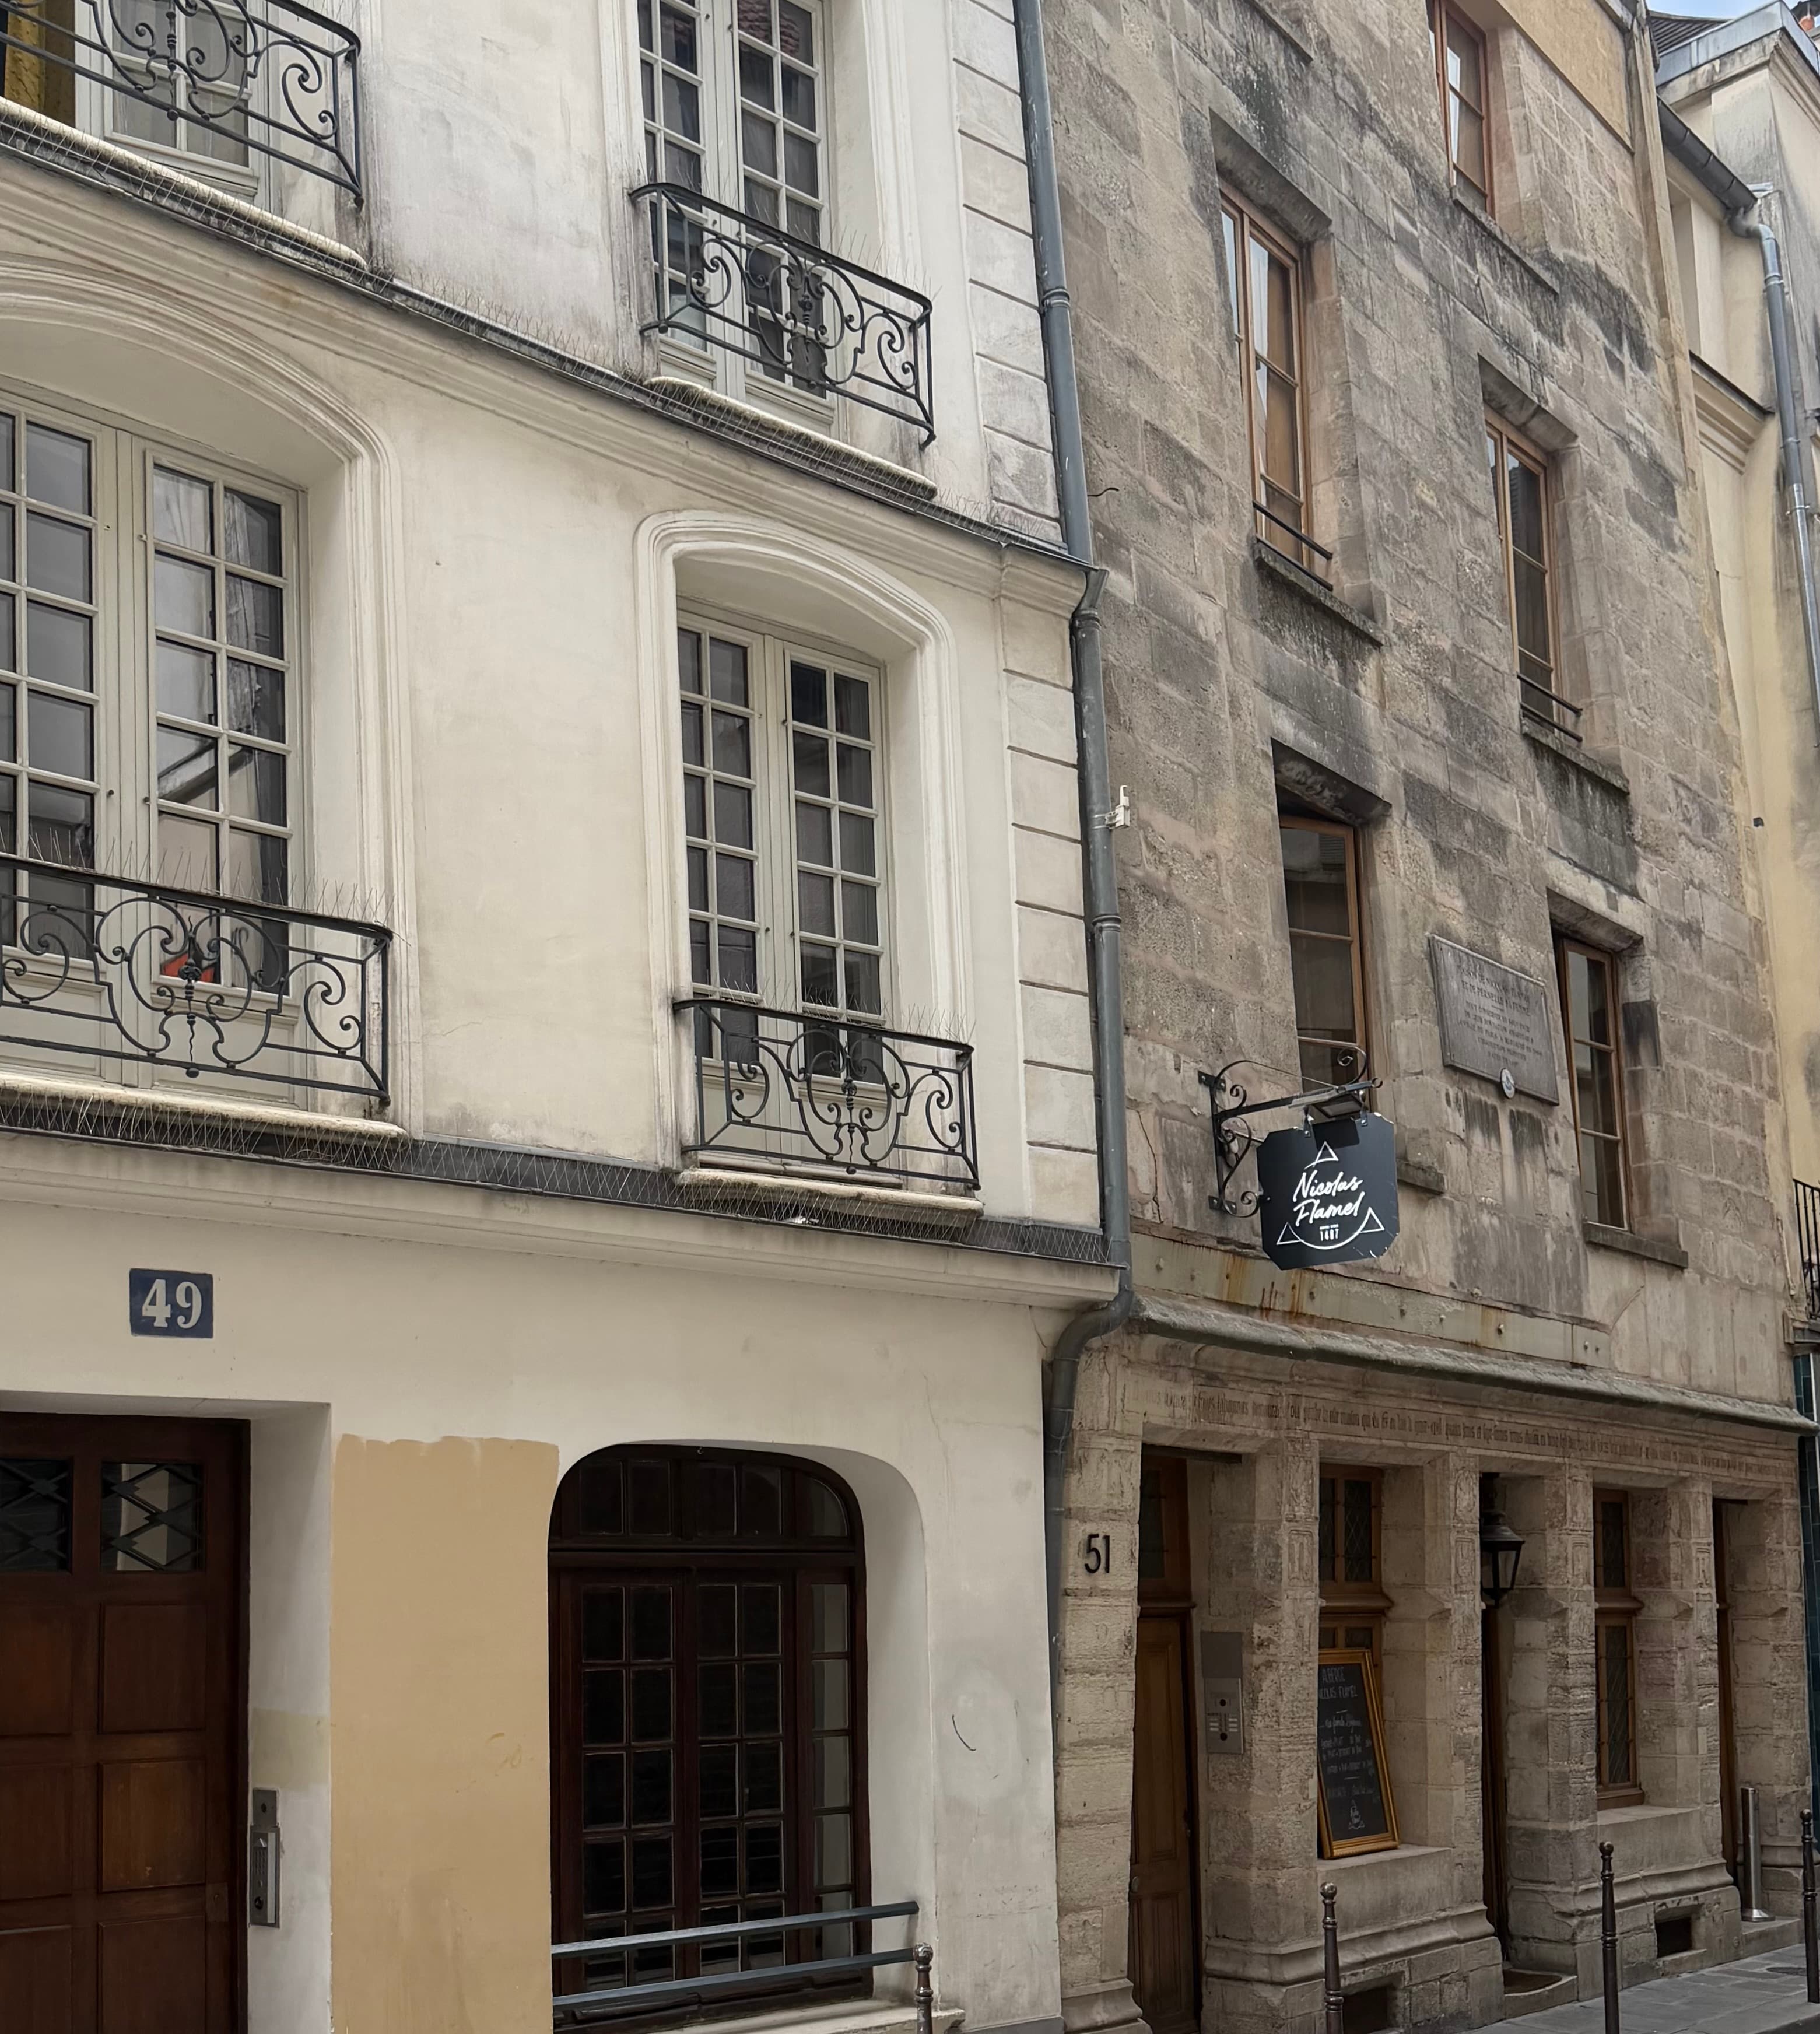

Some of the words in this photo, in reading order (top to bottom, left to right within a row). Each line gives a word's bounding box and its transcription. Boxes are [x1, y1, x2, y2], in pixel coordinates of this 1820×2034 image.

[1293, 1169, 1363, 1202] Nicolas
[1293, 1191, 1365, 1226] Flamel
[142, 1279, 202, 1329] 49
[1084, 1534, 1110, 1574] 51
